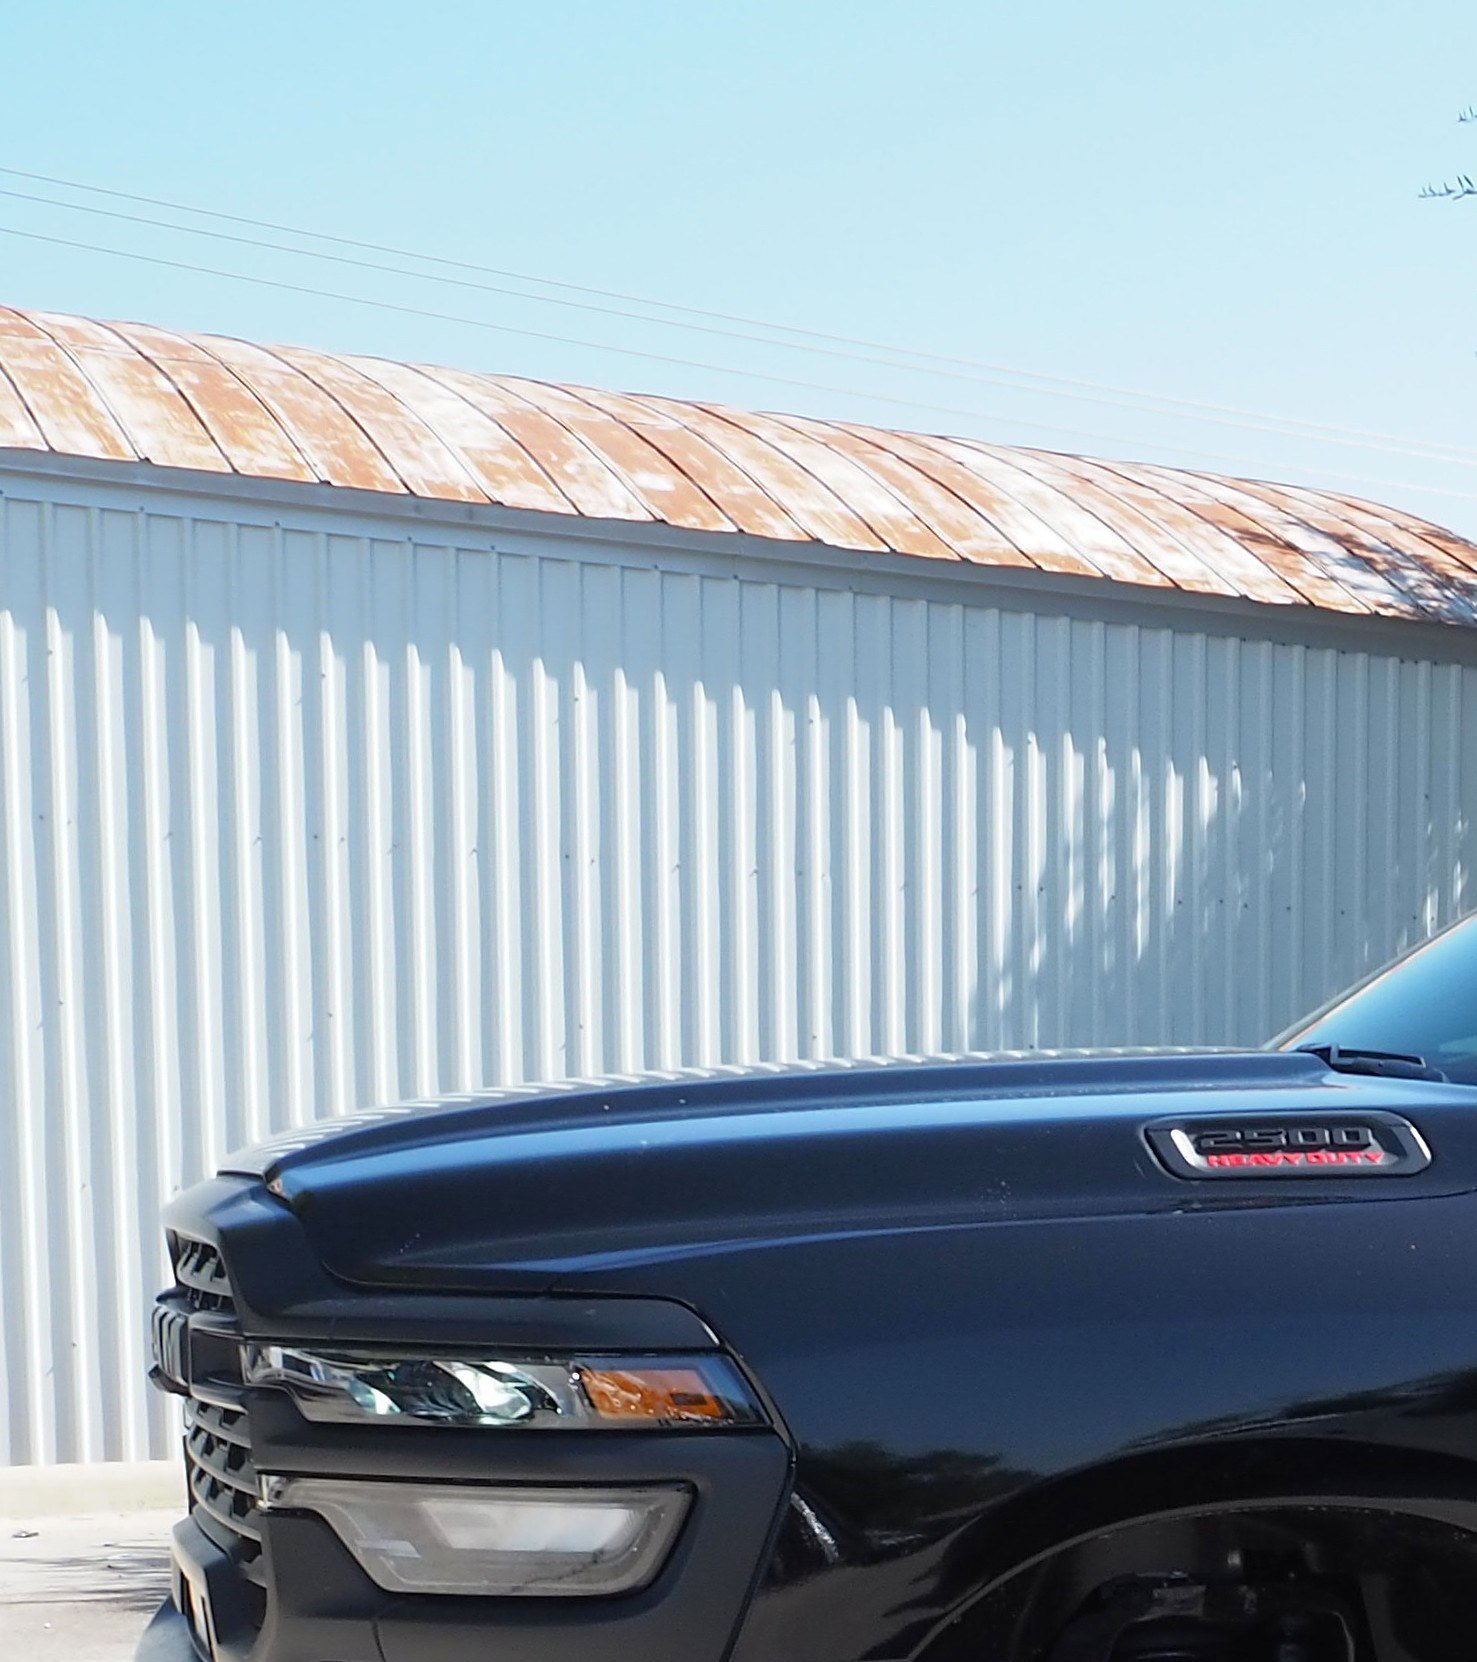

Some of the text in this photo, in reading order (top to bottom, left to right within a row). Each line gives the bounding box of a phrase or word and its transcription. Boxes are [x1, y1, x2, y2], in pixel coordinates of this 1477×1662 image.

[1195, 1126, 1374, 1153] 2500
[1207, 1150, 1386, 1168] HEAVY DUTY
